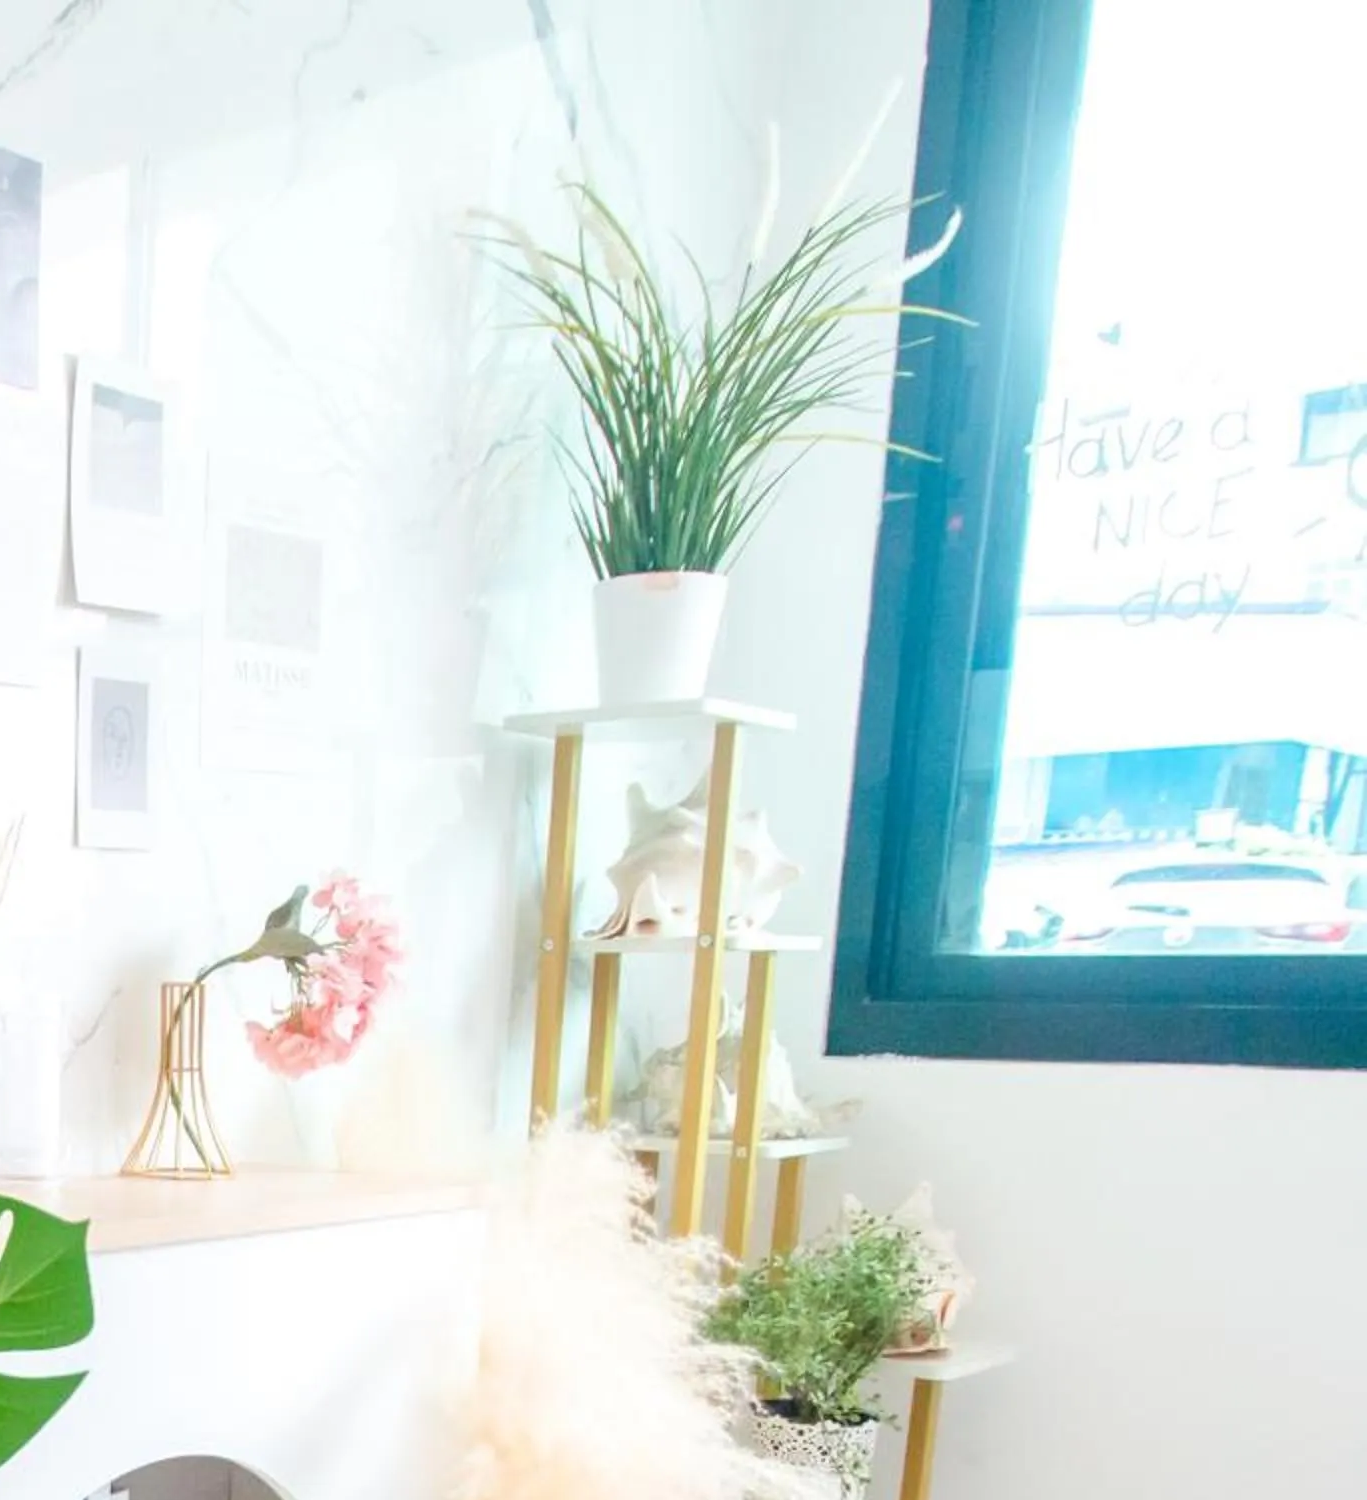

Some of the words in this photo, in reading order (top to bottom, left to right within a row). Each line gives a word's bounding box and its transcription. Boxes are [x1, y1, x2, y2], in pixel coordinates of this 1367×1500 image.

[1210, 400, 1253, 452] a
[1090, 465, 1256, 555] NICE
[1118, 558, 1252, 635] day
